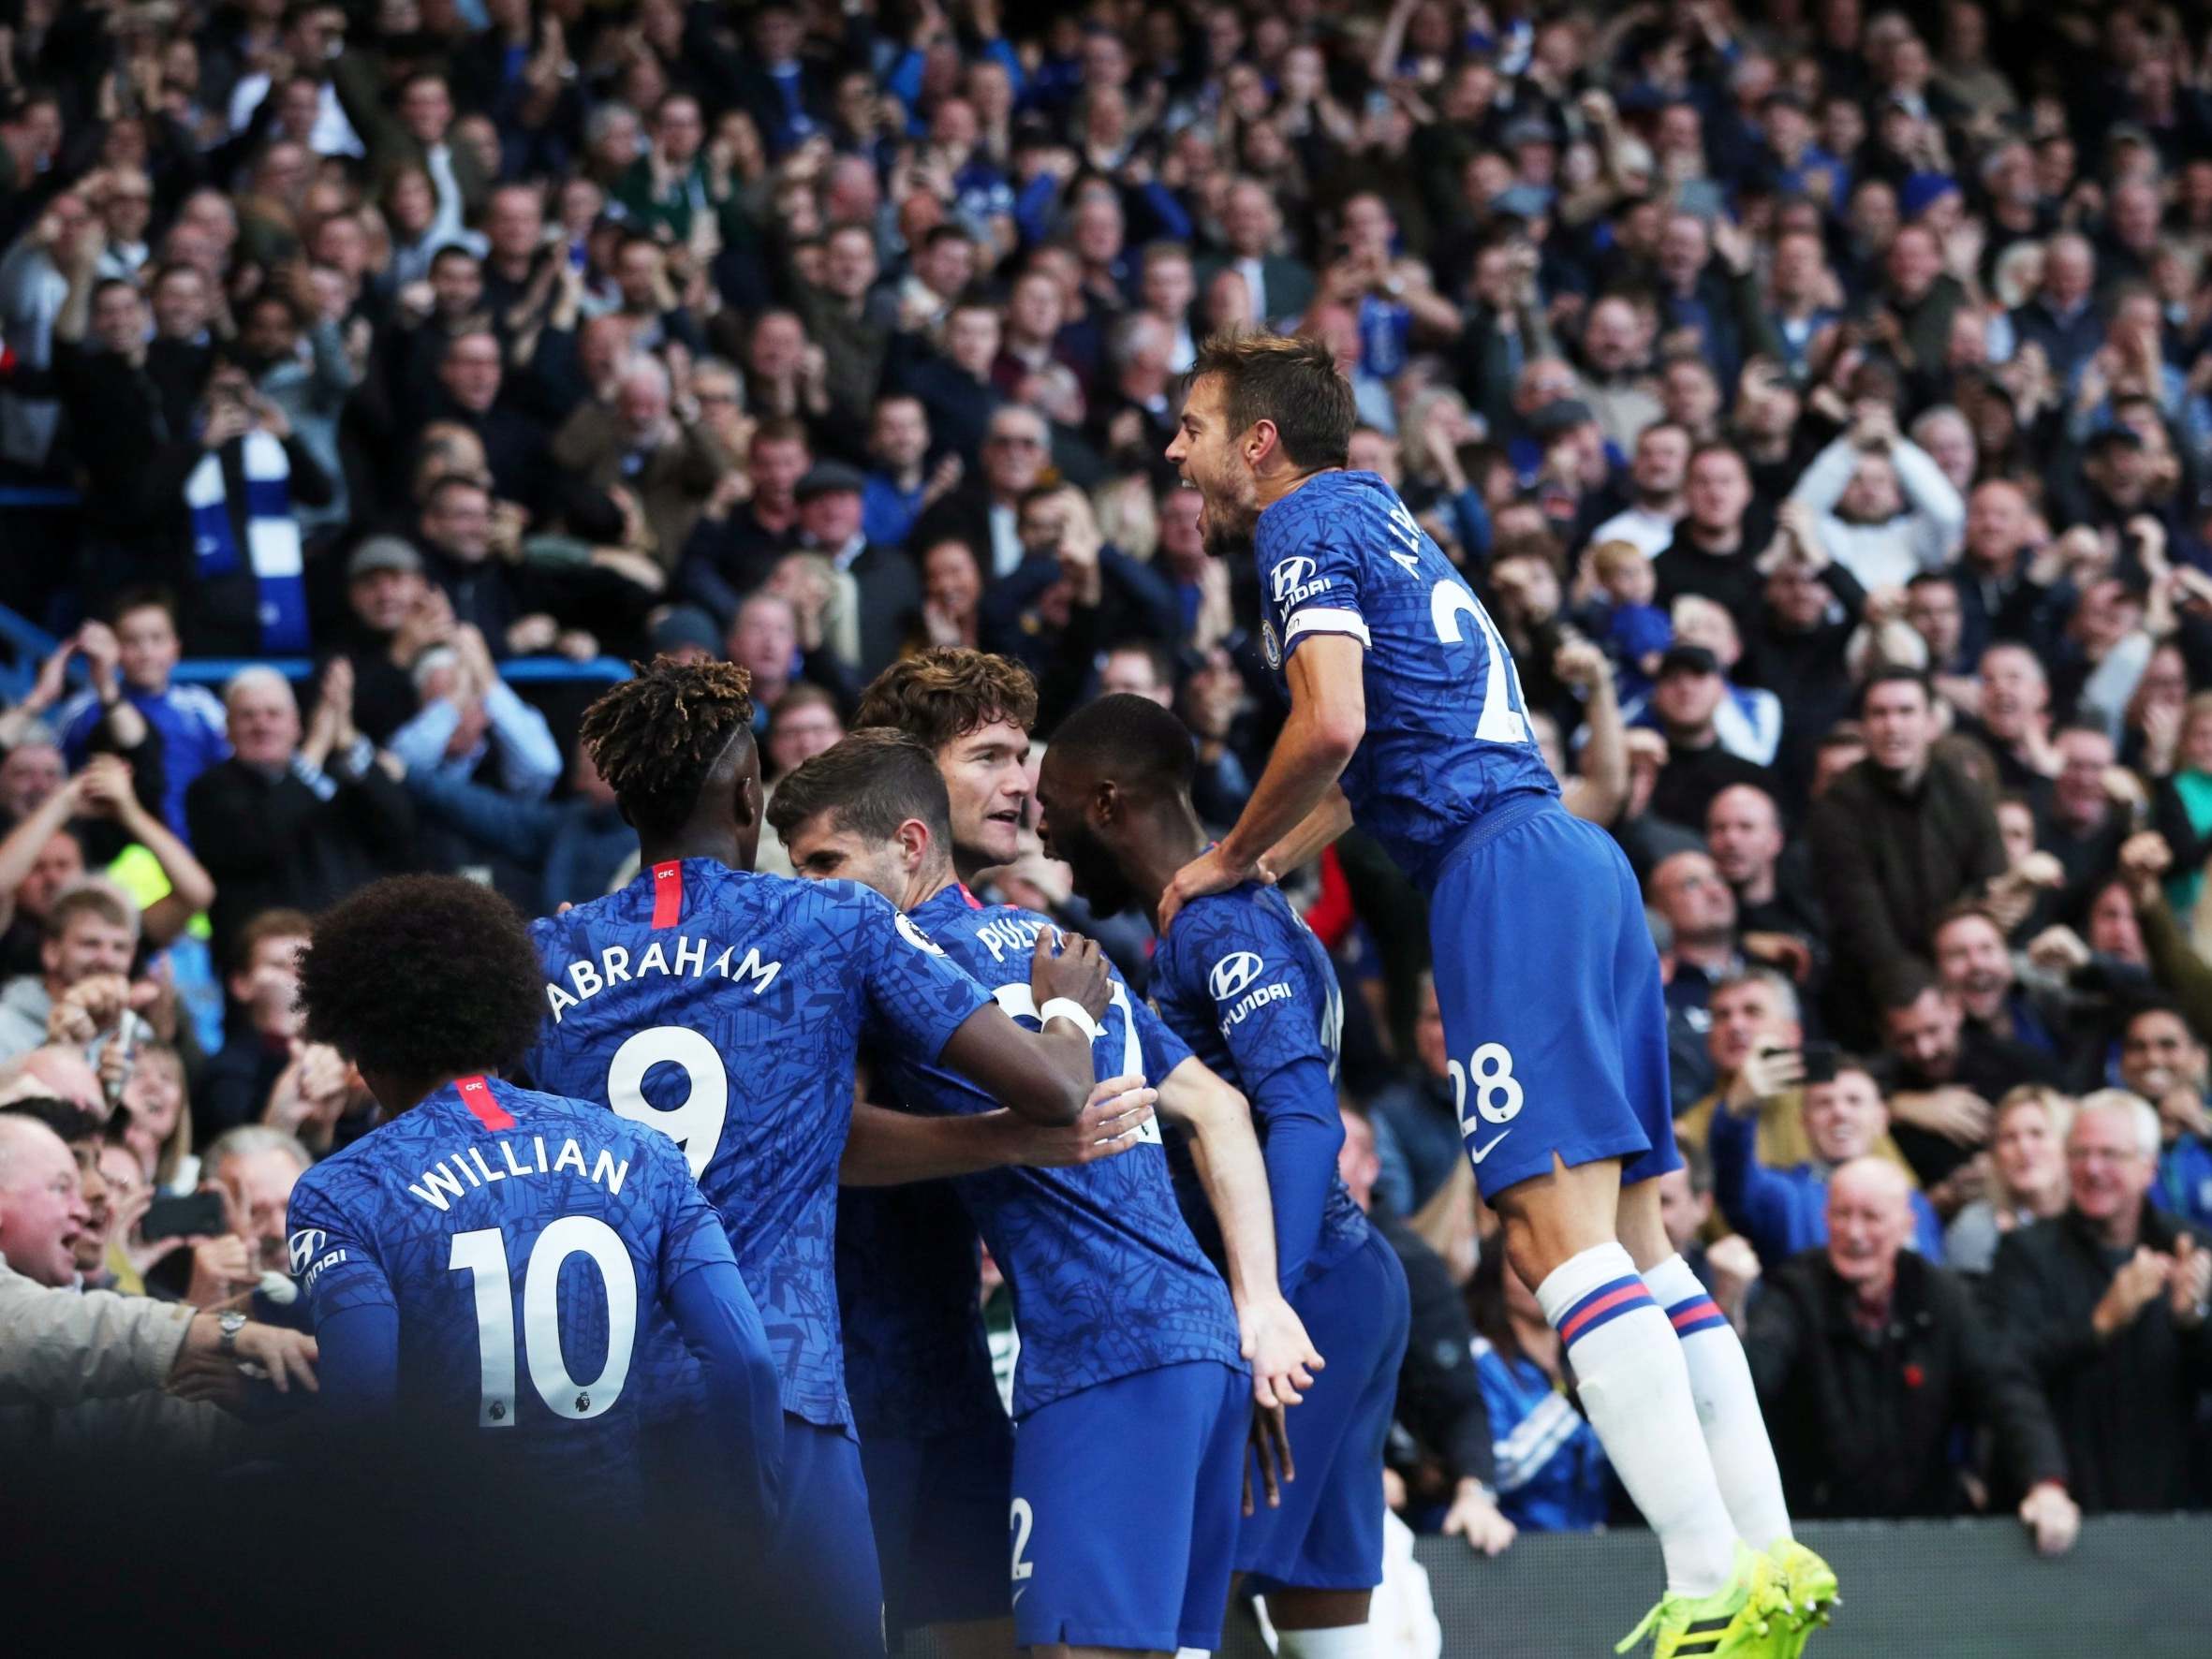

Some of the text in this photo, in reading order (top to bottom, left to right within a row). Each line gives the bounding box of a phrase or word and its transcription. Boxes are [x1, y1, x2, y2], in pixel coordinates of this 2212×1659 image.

[657, 869, 674, 879] CFC
[546, 936, 782, 1023] ABRAHAM
[465, 1082, 483, 1092] CFC
[608, 1026, 728, 1186] 9
[1447, 1042, 1524, 1138] 28
[408, 1137, 629, 1211] WILLIAN
[449, 1215, 638, 1427] 10
[1010, 1497, 1033, 1580] 2
